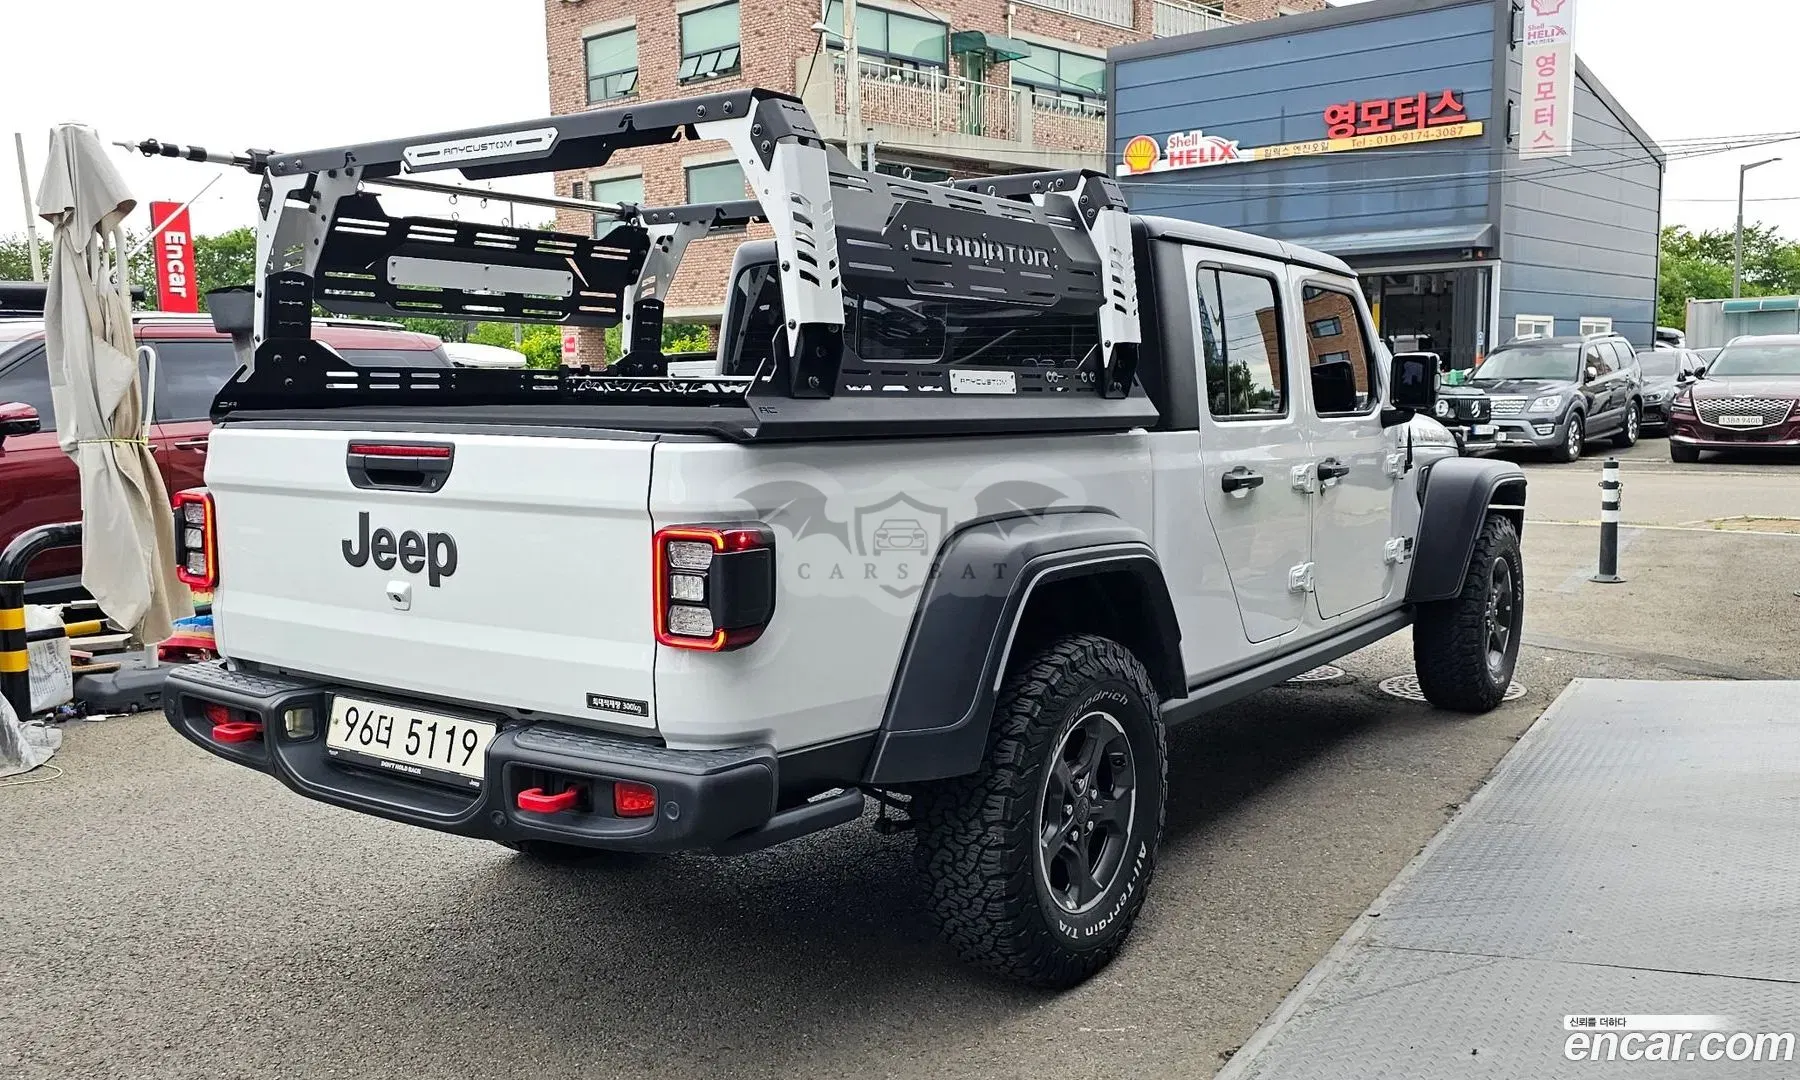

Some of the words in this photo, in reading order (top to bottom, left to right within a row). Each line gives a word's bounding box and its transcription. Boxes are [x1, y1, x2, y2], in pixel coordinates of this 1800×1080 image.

[1528, 26, 1566, 39] HELIX
[1324, 88, 1467, 139] 영모터스
[1532, 52, 1556, 150] 영모터스
[443, 139, 513, 156] ANYCUSTOM
[1169, 133, 1198, 149] Shell
[1169, 143, 1236, 167] HELIX
[1352, 138, 1366, 148] Tel
[1376, 125, 1464, 145] 010-9174-3087
[164, 231, 188, 298] Encar
[910, 228, 1050, 268] GLADIATOR
[341, 511, 457, 588] Jeep
[344, 706, 394, 749] 96더
[405, 718, 478, 767] 5119
[1085, 841, 1147, 936] All-Terrain
